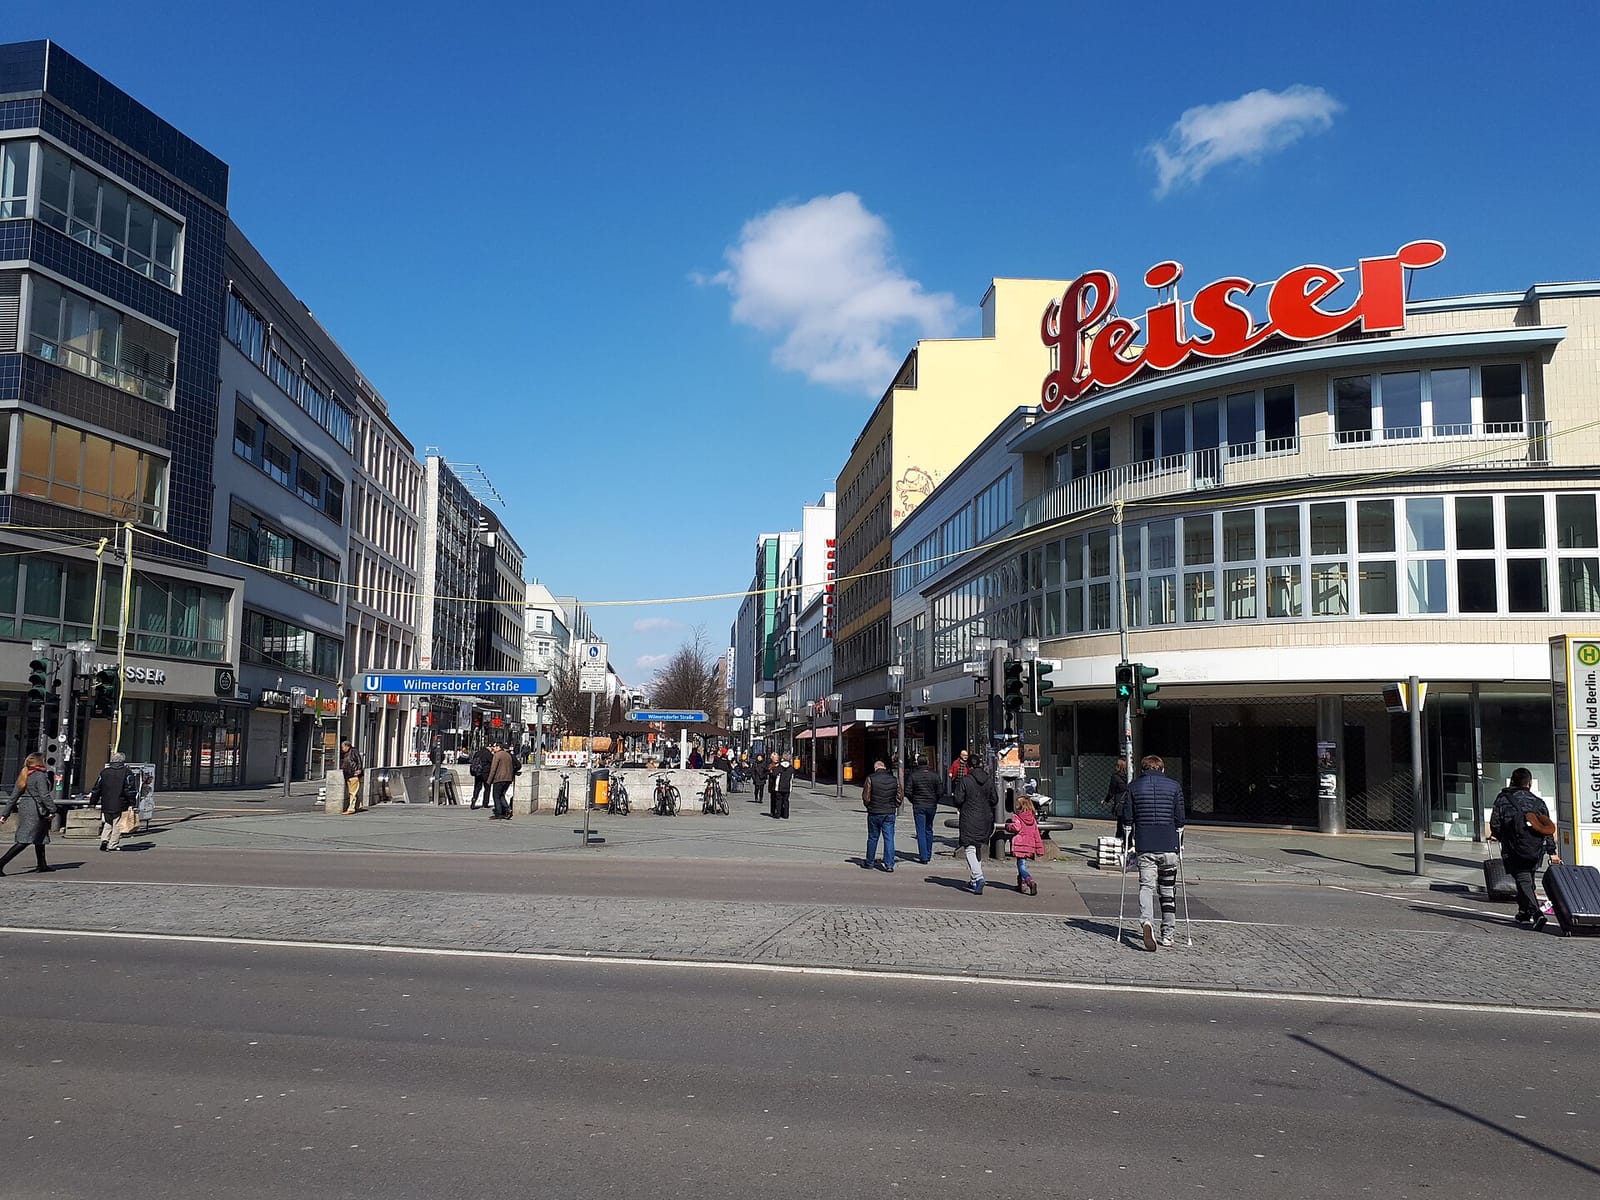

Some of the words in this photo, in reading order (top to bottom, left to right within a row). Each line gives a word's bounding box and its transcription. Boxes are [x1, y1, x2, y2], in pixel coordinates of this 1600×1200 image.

[1041, 239, 1447, 413] Leiser
[367, 677, 380, 691] U
[403, 679, 482, 692] Wilmersdorfer
[484, 681, 520, 692] Straße
[1585, 670, 1597, 704] Berlin.
[1586, 706, 1598, 728] Und
